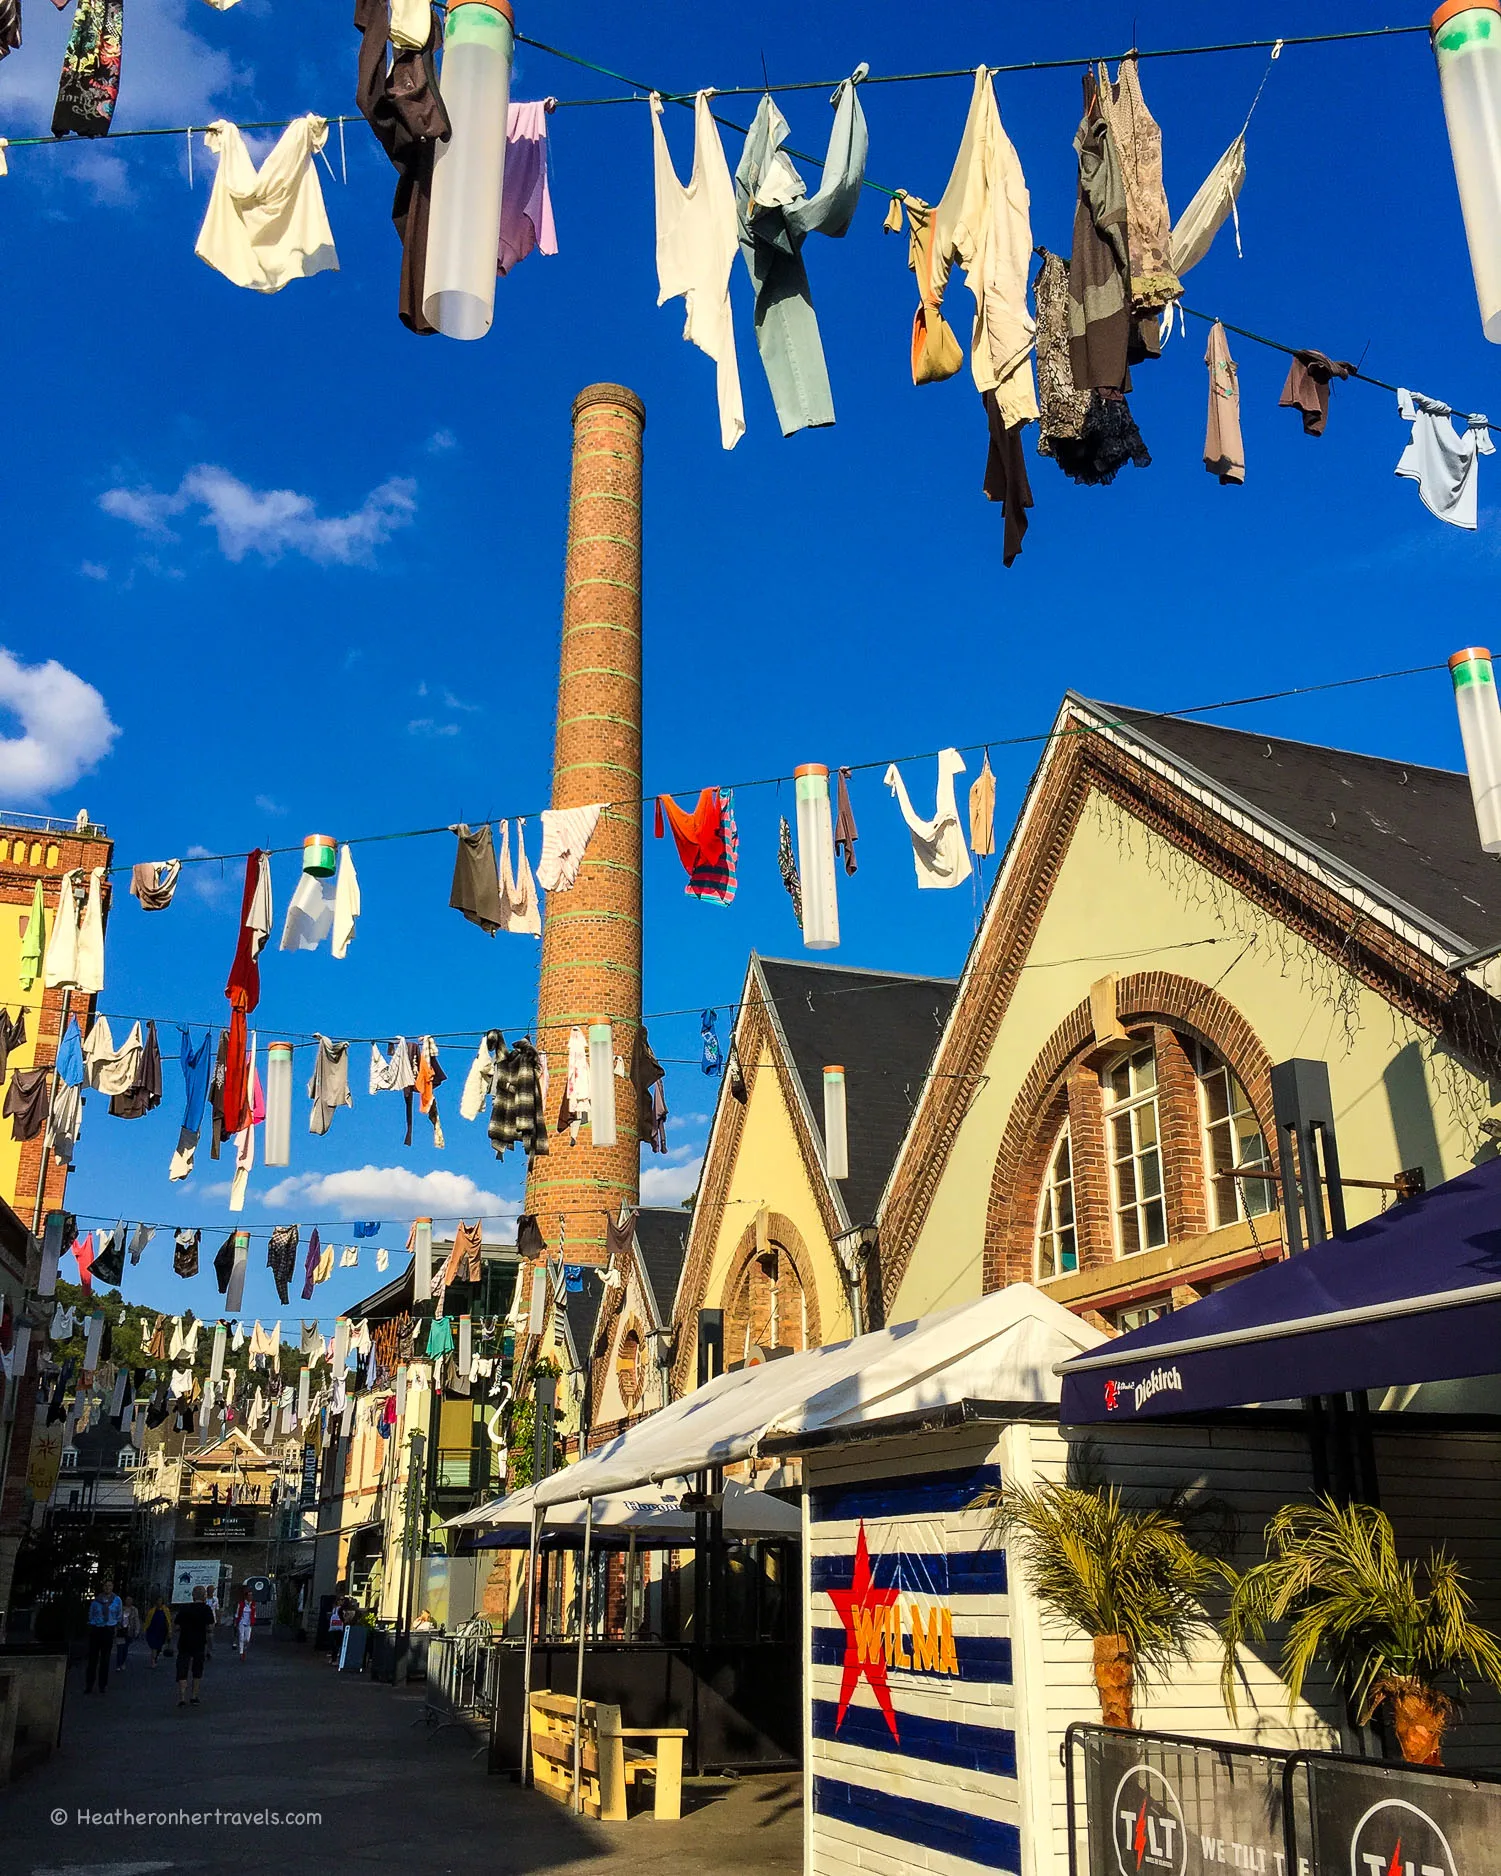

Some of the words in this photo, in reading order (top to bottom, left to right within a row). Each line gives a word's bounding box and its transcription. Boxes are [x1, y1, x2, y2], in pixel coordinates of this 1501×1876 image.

[1134, 1366, 1182, 1411] Diekirch
[851, 1604, 960, 1675] WILMA
[1120, 1800, 1177, 1868] TILT
[1201, 1834, 1226, 1863] WE
[1231, 1841, 1267, 1872] TILT
[1273, 1851, 1310, 1876] TE
